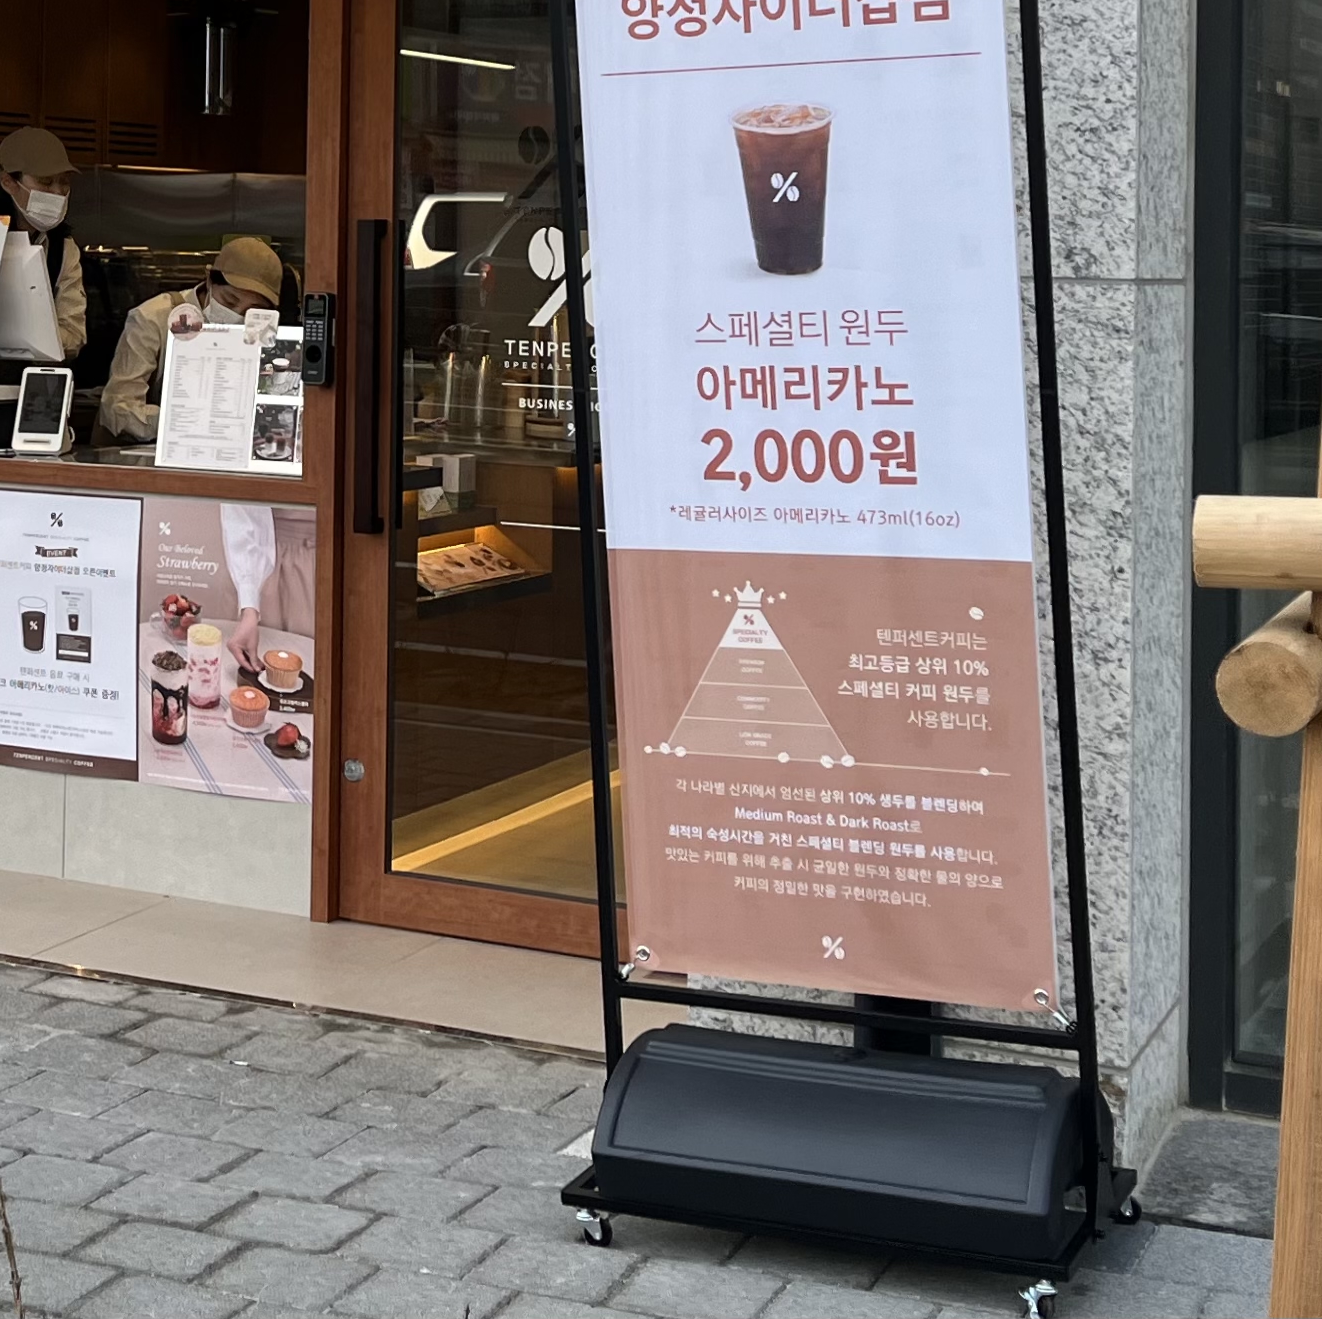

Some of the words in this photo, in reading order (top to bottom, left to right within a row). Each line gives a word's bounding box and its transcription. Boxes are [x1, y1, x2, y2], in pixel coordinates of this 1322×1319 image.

[694, 309, 830, 347] 스페셜티
[838, 308, 909, 347] 원두
[696, 365, 914, 411] 아메리카노
[518, 397, 574, 411] BUSINES
[700, 427, 919, 492] 2,000원
[773, 507, 851, 525] 아메리카노
[857, 509, 961, 529] 473ml(16oz)
[156, 555, 219, 575] Strawberry
[876, 628, 988, 651] 텐퍼센트커피는
[848, 653, 910, 674] 최고등급
[915, 656, 947, 676] 상위
[953, 659, 990, 677] 10%
[837, 680, 900, 700] 스페셜티
[905, 682, 938, 702] 커피
[942, 684, 991, 706] 원두를
[906, 709, 993, 732] 사용합니다.
[820, 789, 845, 805] 상위
[848, 791, 877, 806] 10%
[734, 806, 784, 823] Medium
[786, 810, 824, 826] Roast
[826, 813, 837, 827] &
[839, 814, 870, 830] Dark
[872, 817, 923, 834] Roast로
[769, 832, 793, 848] 거친
[889, 841, 927, 859] 원두를
[930, 845, 999, 866] 사용합니다.
